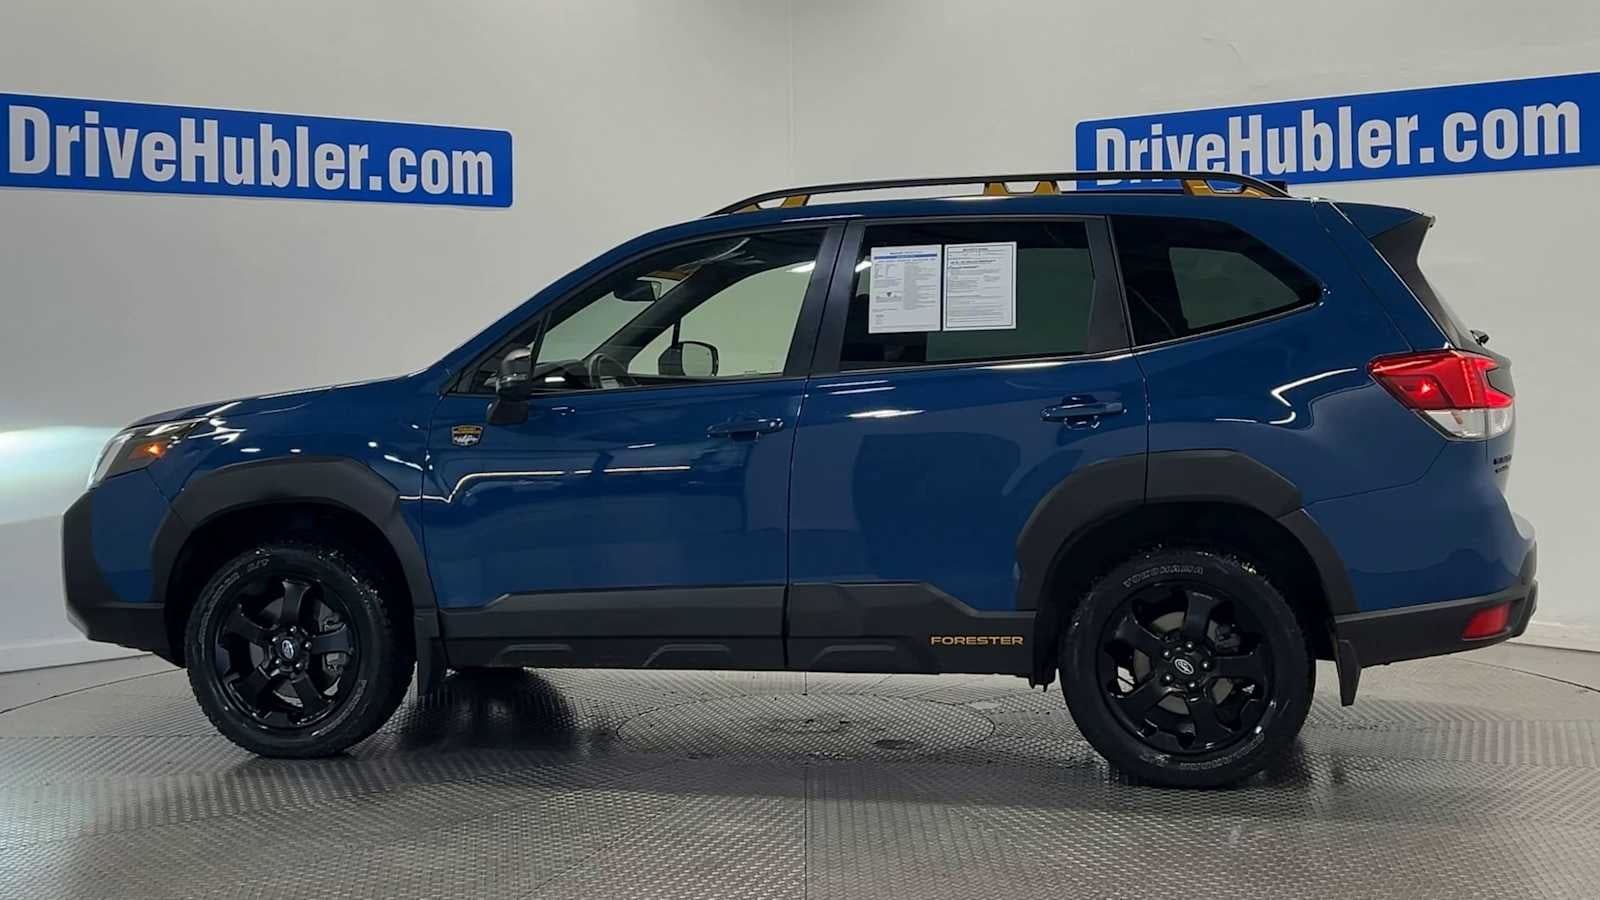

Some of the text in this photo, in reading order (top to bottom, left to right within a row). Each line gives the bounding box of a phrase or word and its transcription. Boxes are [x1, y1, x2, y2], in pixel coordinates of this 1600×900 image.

[8, 105, 495, 196] DriveHubler.com
[1096, 99, 1581, 187] DriveHubler.com
[930, 636, 1024, 645] FORESTER
